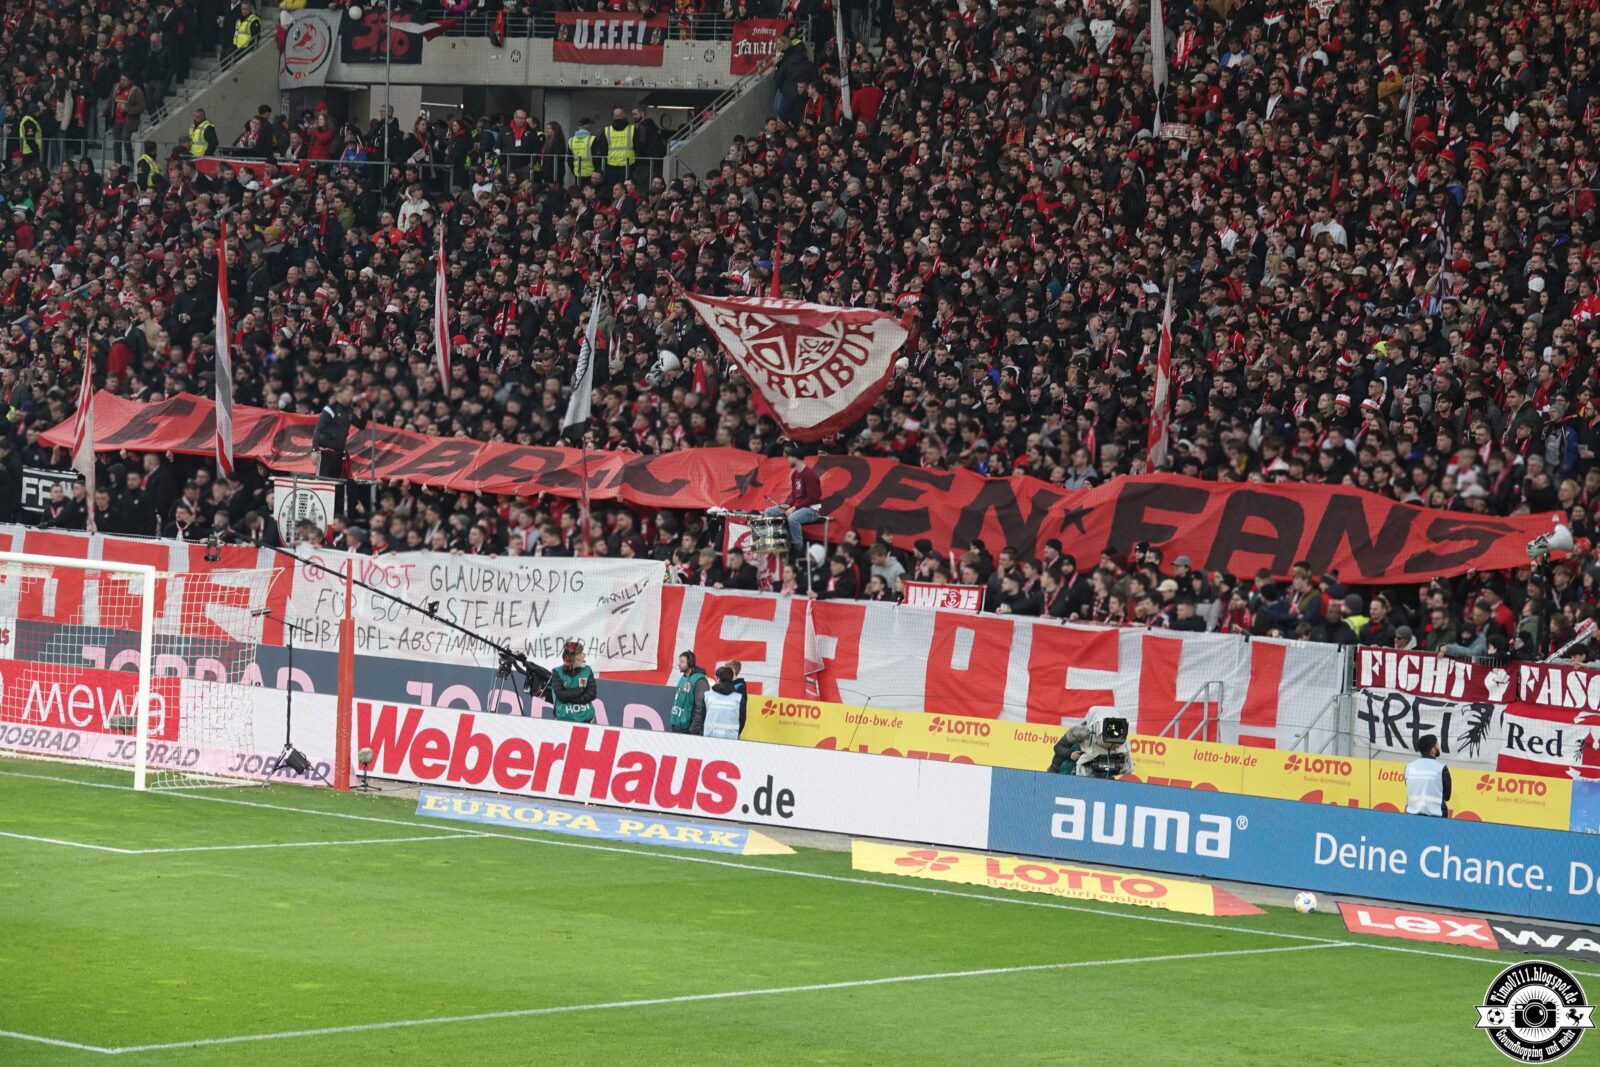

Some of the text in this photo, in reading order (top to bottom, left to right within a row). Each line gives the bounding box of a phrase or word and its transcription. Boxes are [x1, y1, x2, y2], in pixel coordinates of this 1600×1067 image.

[792, 453, 1072, 555] DEN
[1104, 480, 1527, 581] FANS
[357, 559, 416, 588] VOGT
[430, 563, 585, 593] GLAUBWÜRDIG
[447, 598, 551, 630] STEHEN
[1359, 649, 1473, 699] FIGHT
[779, 702, 822, 720] LOTTO
[844, 711, 904, 729] lotto-bw.de
[1357, 687, 1458, 754] FREI
[0, 724, 81, 753] JOBRAD
[946, 719, 991, 737] LOTTO
[1013, 728, 1059, 746] lotto-bw
[1506, 722, 1564, 758] Red
[355, 701, 796, 820] WeberHaus.de
[1130, 739, 1167, 757] OTTO
[1193, 748, 1258, 768] lotto-bw.de
[1304, 757, 1352, 777] LOTTO
[1497, 778, 1548, 797] LOTTO
[425, 793, 742, 848] EUROPA PARK
[985, 857, 1168, 898] LOTTO
[1314, 831, 1408, 875] Deine
[1418, 844, 1553, 892] Chance.
